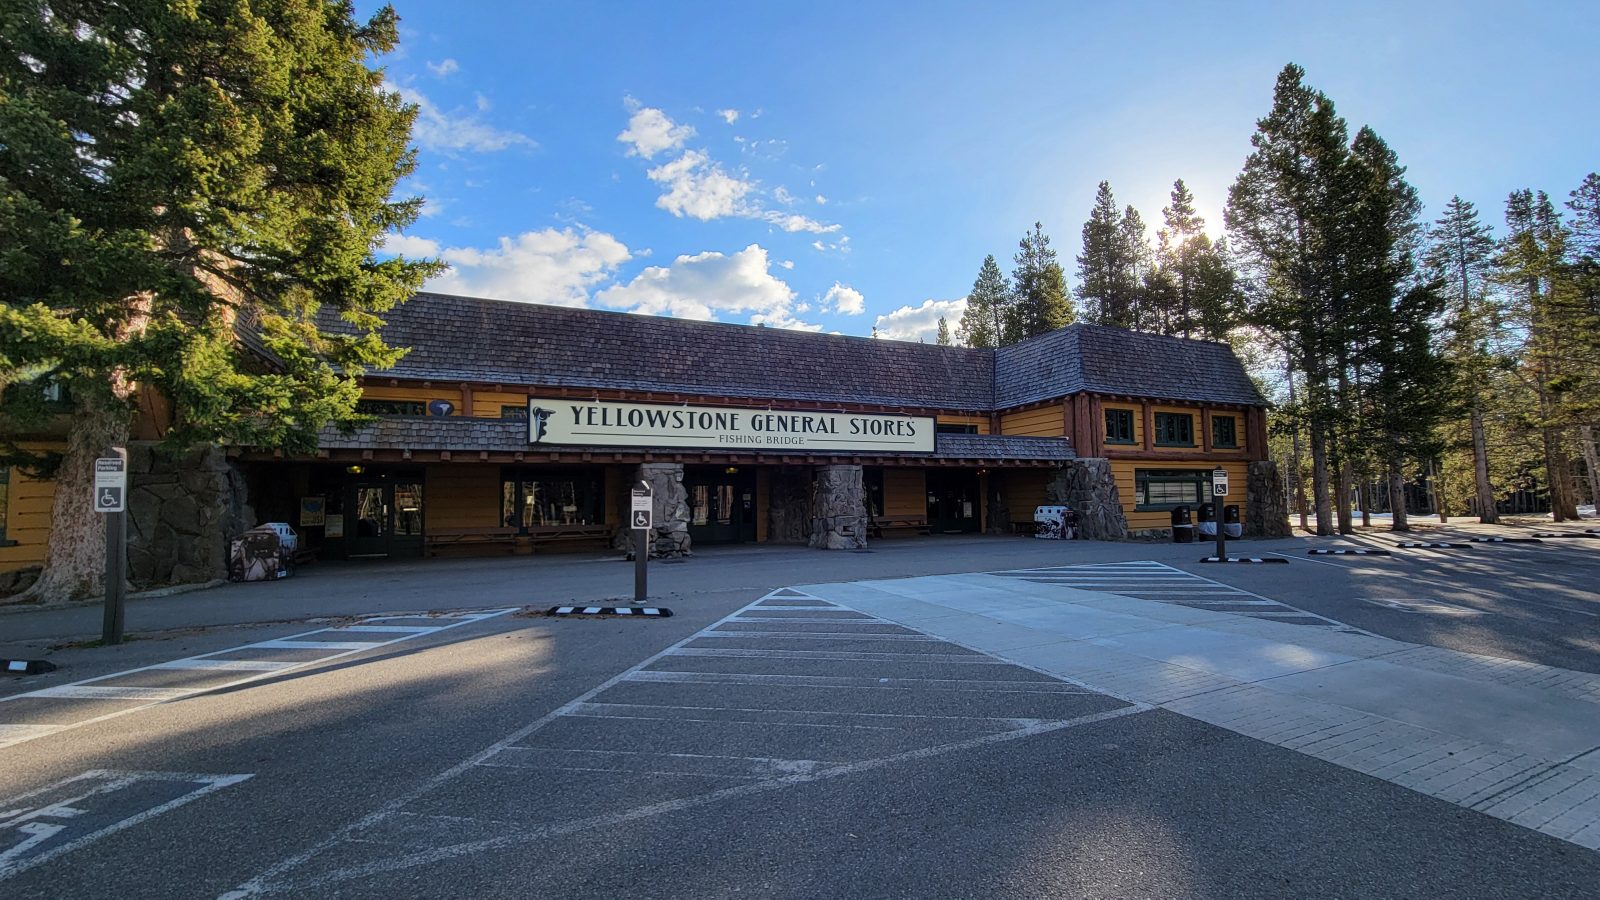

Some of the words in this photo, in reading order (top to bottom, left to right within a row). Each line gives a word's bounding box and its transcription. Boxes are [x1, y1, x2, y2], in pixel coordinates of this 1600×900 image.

[570, 406, 739, 430] YELLOWSTONE
[751, 414, 839, 434] GENERAL
[850, 418, 916, 437] STORES
[719, 434, 762, 445] FISHING
[766, 436, 805, 445] BRIDGE
